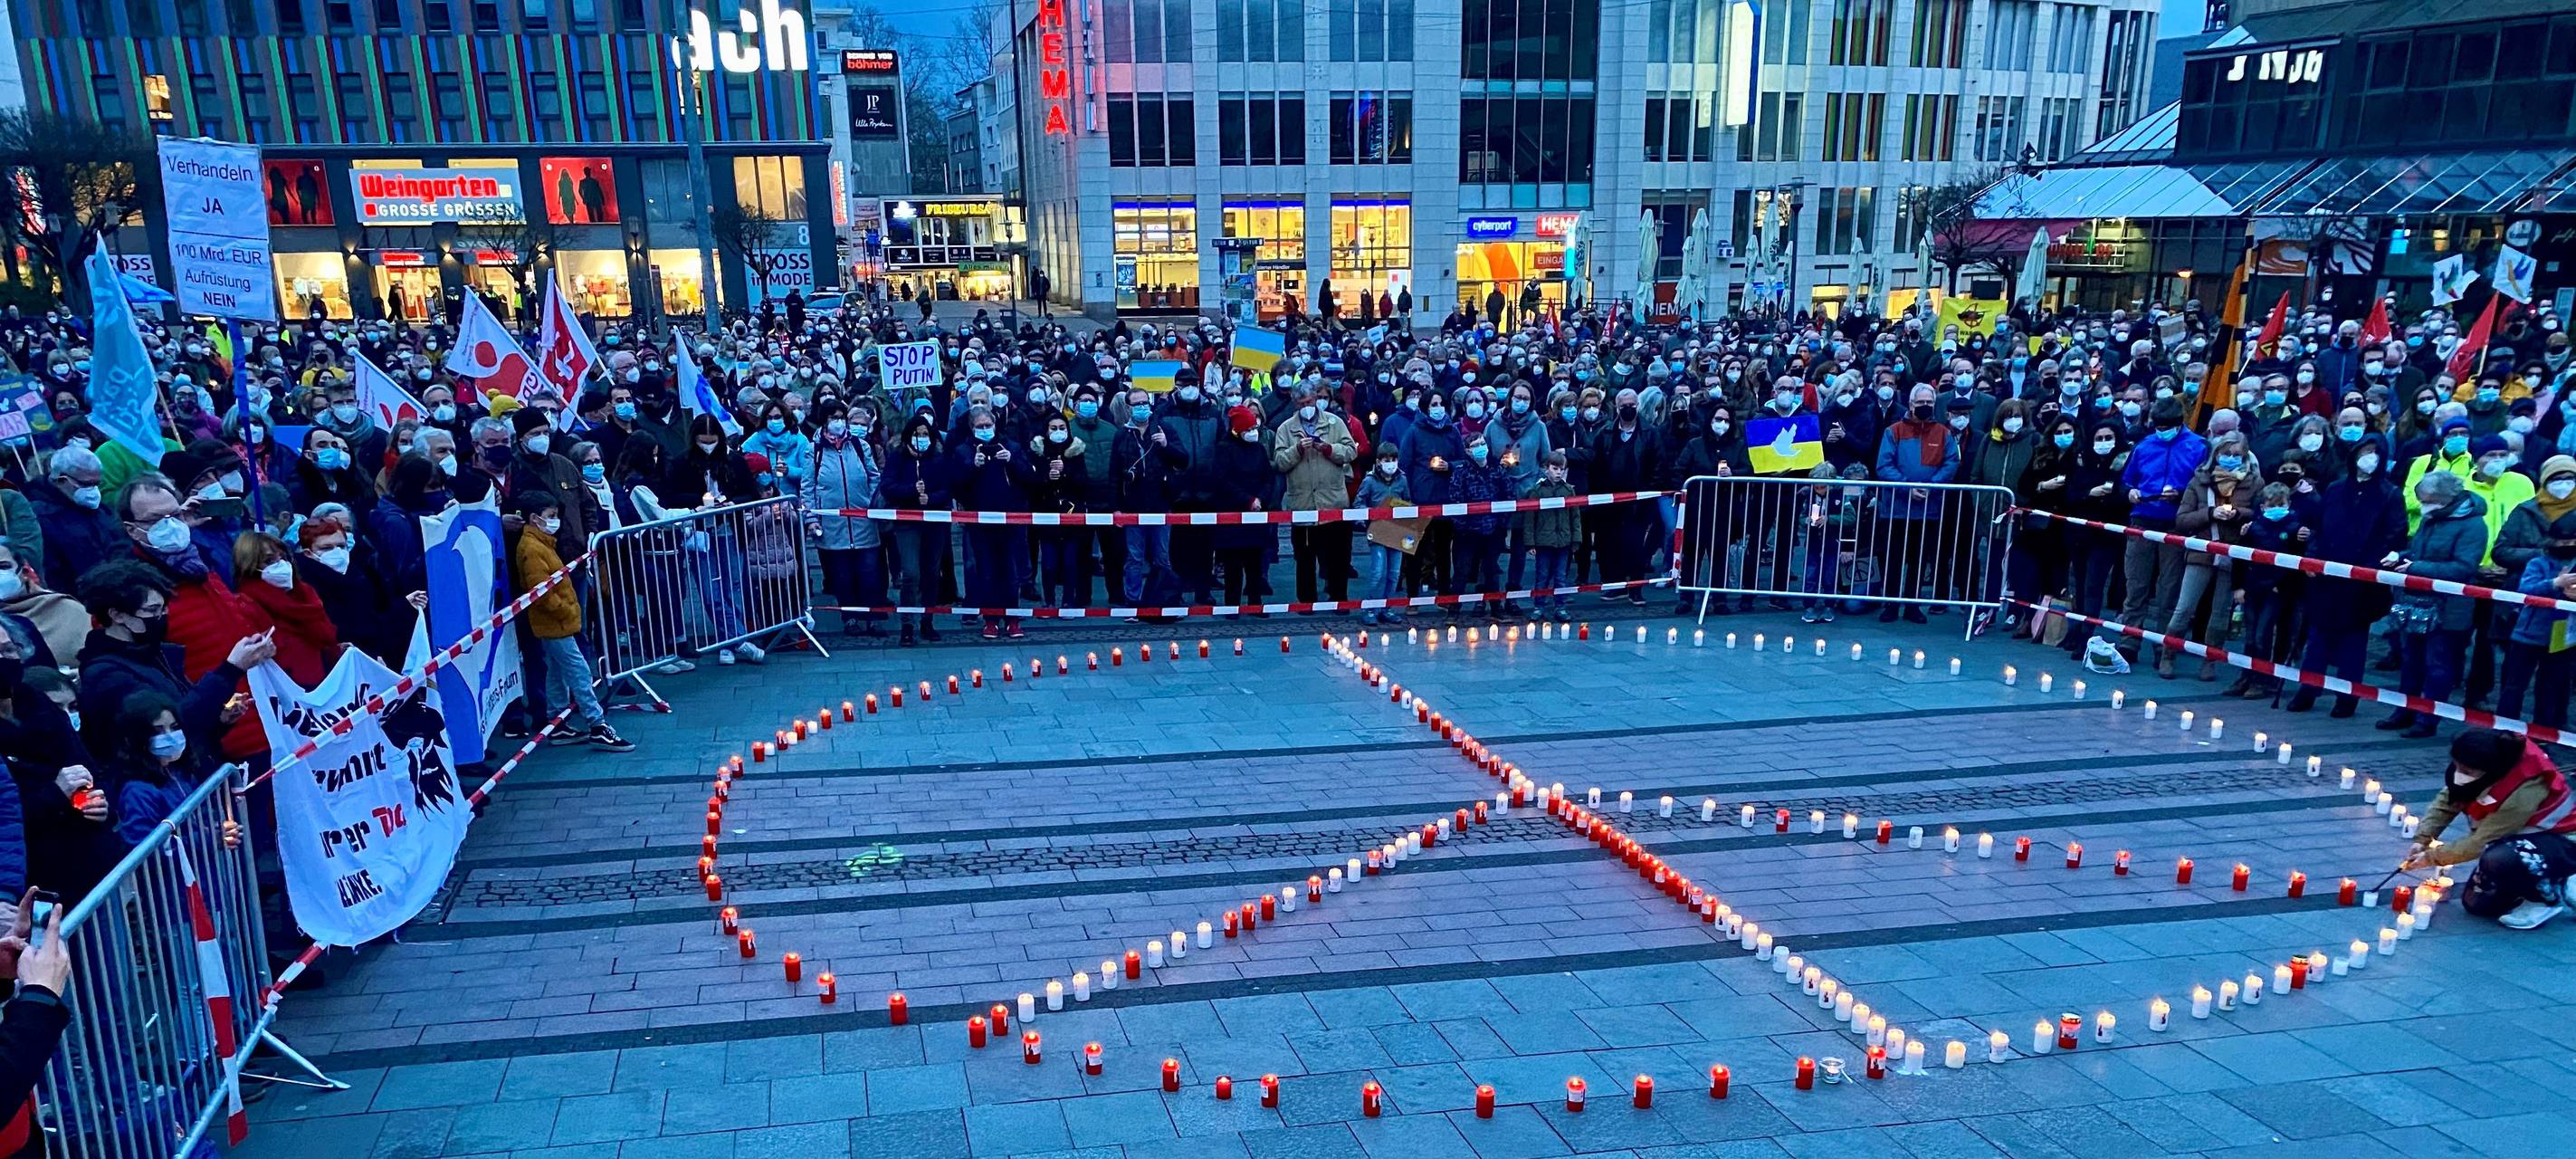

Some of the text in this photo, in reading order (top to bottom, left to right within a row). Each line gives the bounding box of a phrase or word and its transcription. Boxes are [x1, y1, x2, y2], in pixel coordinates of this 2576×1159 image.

[847, 59, 893, 69] böhmer
[1039, 0, 1069, 135] HEMA
[866, 94, 880, 110] JP
[167, 155, 253, 182] Verhandeln
[358, 173, 500, 204] Weingarten
[202, 196, 224, 216] JA
[378, 201, 516, 217] GROSSE GRÖSSEN
[925, 203, 992, 216] FRISEURSA
[797, 225, 810, 246] 8
[1473, 220, 1512, 233] cyberport
[175, 243, 196, 259] 100
[233, 249, 262, 265] EUR
[769, 273, 812, 286] MODE
[203, 291, 236, 308] NEIN
[883, 345, 935, 368] STOP
[892, 367, 935, 386] PUTIN
